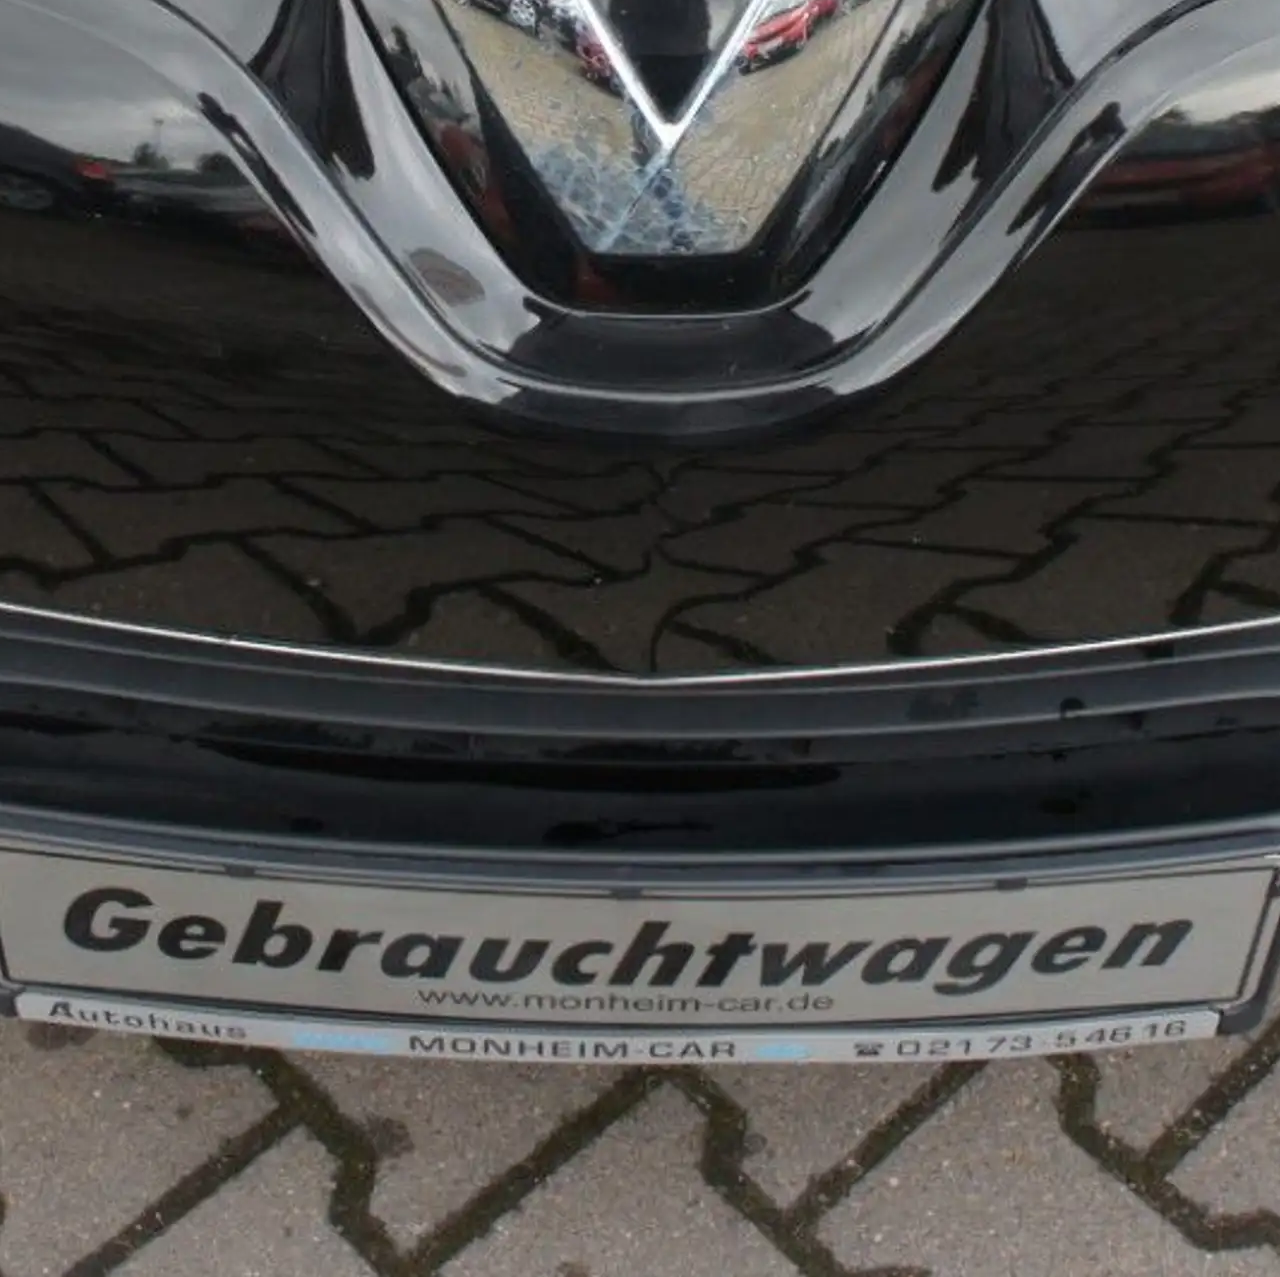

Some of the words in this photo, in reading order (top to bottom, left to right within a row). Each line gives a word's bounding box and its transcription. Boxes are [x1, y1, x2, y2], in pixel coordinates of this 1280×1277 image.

[63, 887, 1193, 996] Gebrauchtwagen
[49, 1001, 246, 1039] Autohaus
[418, 989, 835, 1014] www.monheim-car.de
